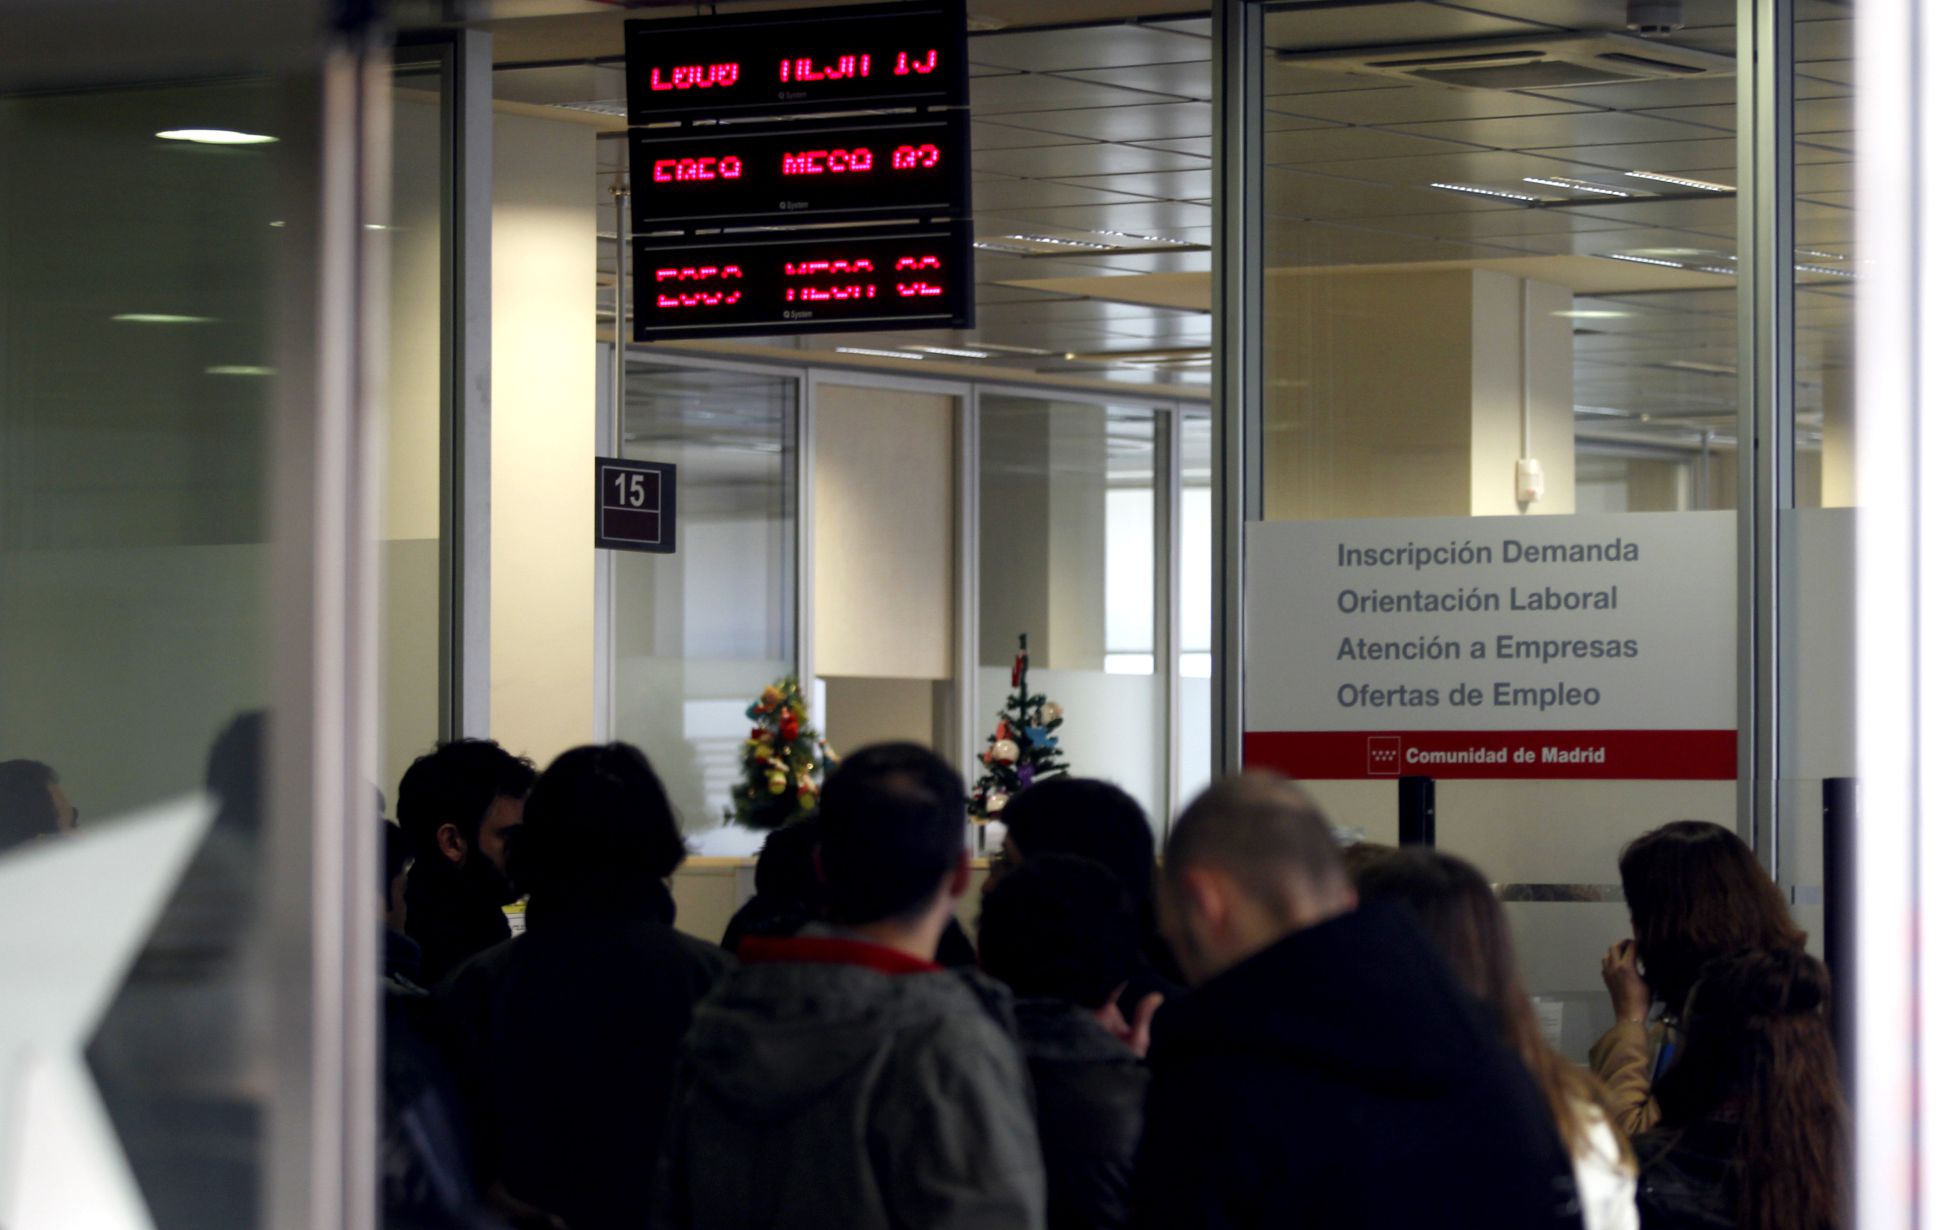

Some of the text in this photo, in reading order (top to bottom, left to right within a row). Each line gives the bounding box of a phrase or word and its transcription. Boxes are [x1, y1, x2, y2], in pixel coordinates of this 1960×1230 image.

[614, 472, 645, 507] 15
[1338, 537, 1639, 571] Inscripción Demanda
[1337, 585, 1618, 614] Orientación Laboral
[1336, 634, 1639, 664] Atención a Empresas
[1337, 681, 1601, 712] Ofertas de Empleo
[1406, 746, 1605, 764] Comunidad de Madrid
